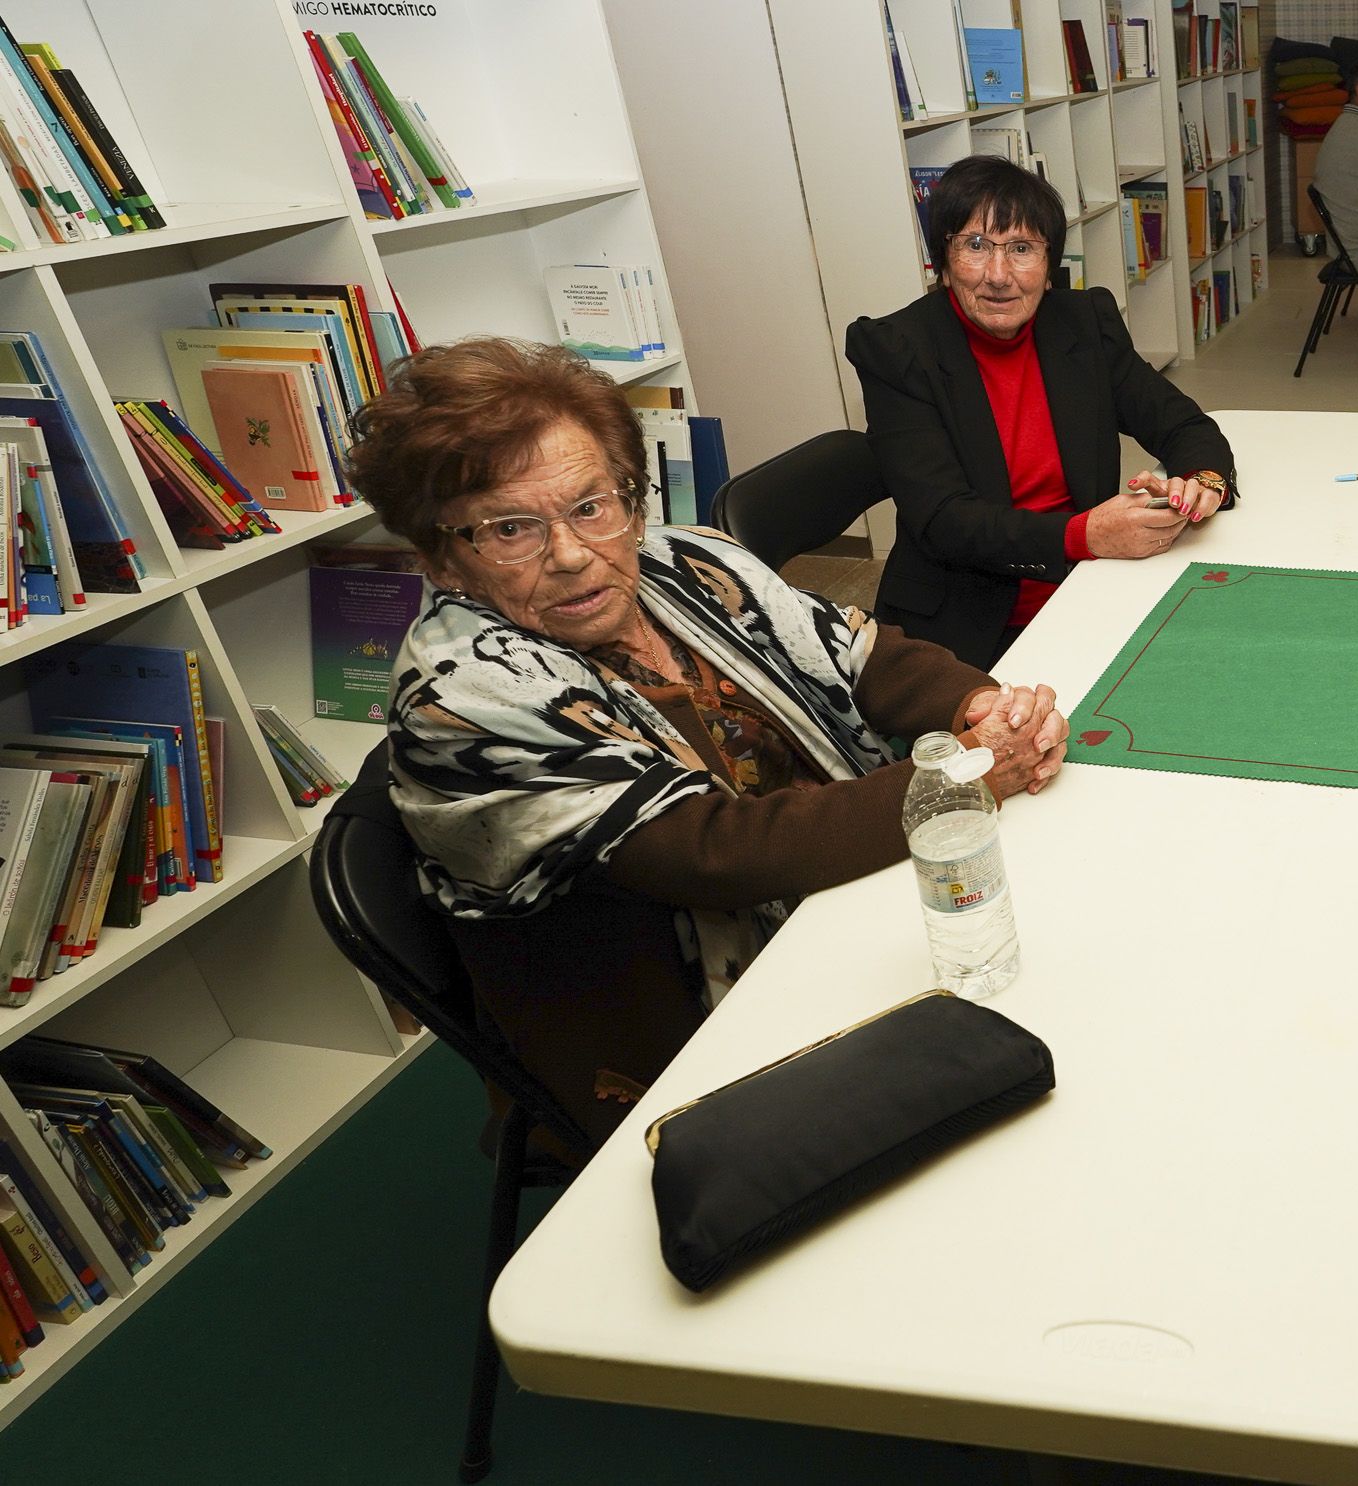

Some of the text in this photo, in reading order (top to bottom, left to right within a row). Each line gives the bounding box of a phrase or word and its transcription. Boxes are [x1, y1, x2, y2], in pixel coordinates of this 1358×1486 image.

[331, 1, 437, 16] HEMATOCRÍTICO
[111, 145, 135, 180] VENEZIA
[11, 877, 19, 886] de
[954, 890, 984, 906] FROIZ
